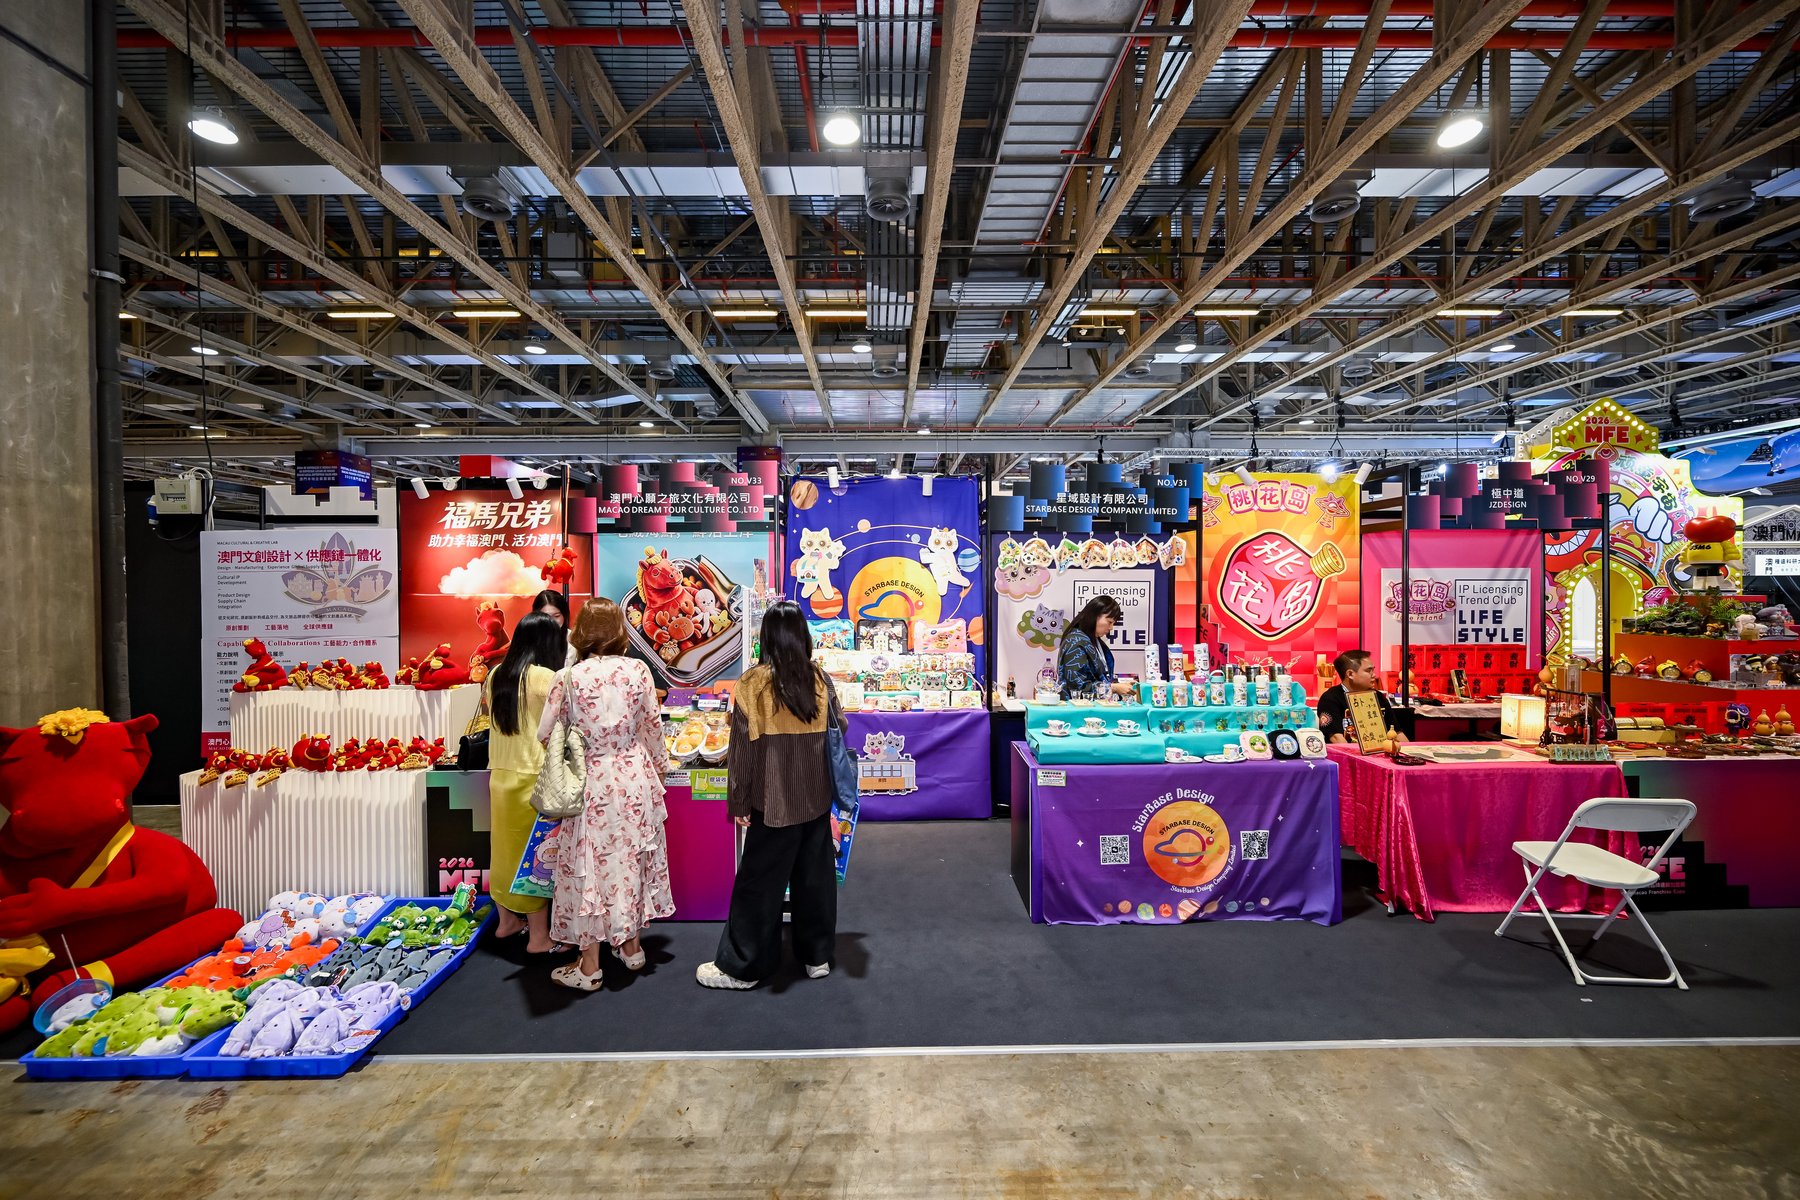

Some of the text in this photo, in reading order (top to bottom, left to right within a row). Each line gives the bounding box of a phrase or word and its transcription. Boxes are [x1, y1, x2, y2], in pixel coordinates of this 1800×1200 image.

[1585, 416, 1610, 424] 2026
[1585, 426, 1630, 444] MFE
[731, 477, 762, 485] NO.V33
[1565, 475, 1596, 483] NO.V29
[610, 493, 751, 504] 澳門心願之旅文化有限公司
[1056, 493, 1149, 505] 星域設計有限公司
[1231, 486, 1305, 509] 桃花岛
[1491, 488, 1524, 499] 極中道
[598, 506, 630, 514] MACAO
[632, 506, 662, 514] DREAM
[664, 506, 687, 514] TOUR
[688, 506, 726, 514] CULTURE
[1025, 505, 1178, 515] STARBASE DESIGN COMPANY LIMITED
[1489, 501, 1527, 509] JZDESIGN
[438, 498, 554, 530] 福馬兄弟
[1753, 524, 1785, 541] 澳門
[428, 533, 562, 548] 助力幸福澳門、活力澳門
[217, 550, 292, 563] 澳門文創設計
[306, 549, 382, 562] 供應鏈一體化
[864, 580, 925, 598] STARBASE DESIGN
[1078, 585, 1146, 598] IP Licensing
[1458, 584, 1524, 596] IP Licensing
[1458, 595, 1517, 605] Trend Club
[1458, 609, 1503, 625] LIFE
[1106, 630, 1146, 644] YLE
[1457, 627, 1524, 643] STYLE
[1132, 787, 1215, 833] StarBase Design
[1159, 819, 1215, 836] STARBASE DESIGN
[439, 857, 475, 869] 2026
